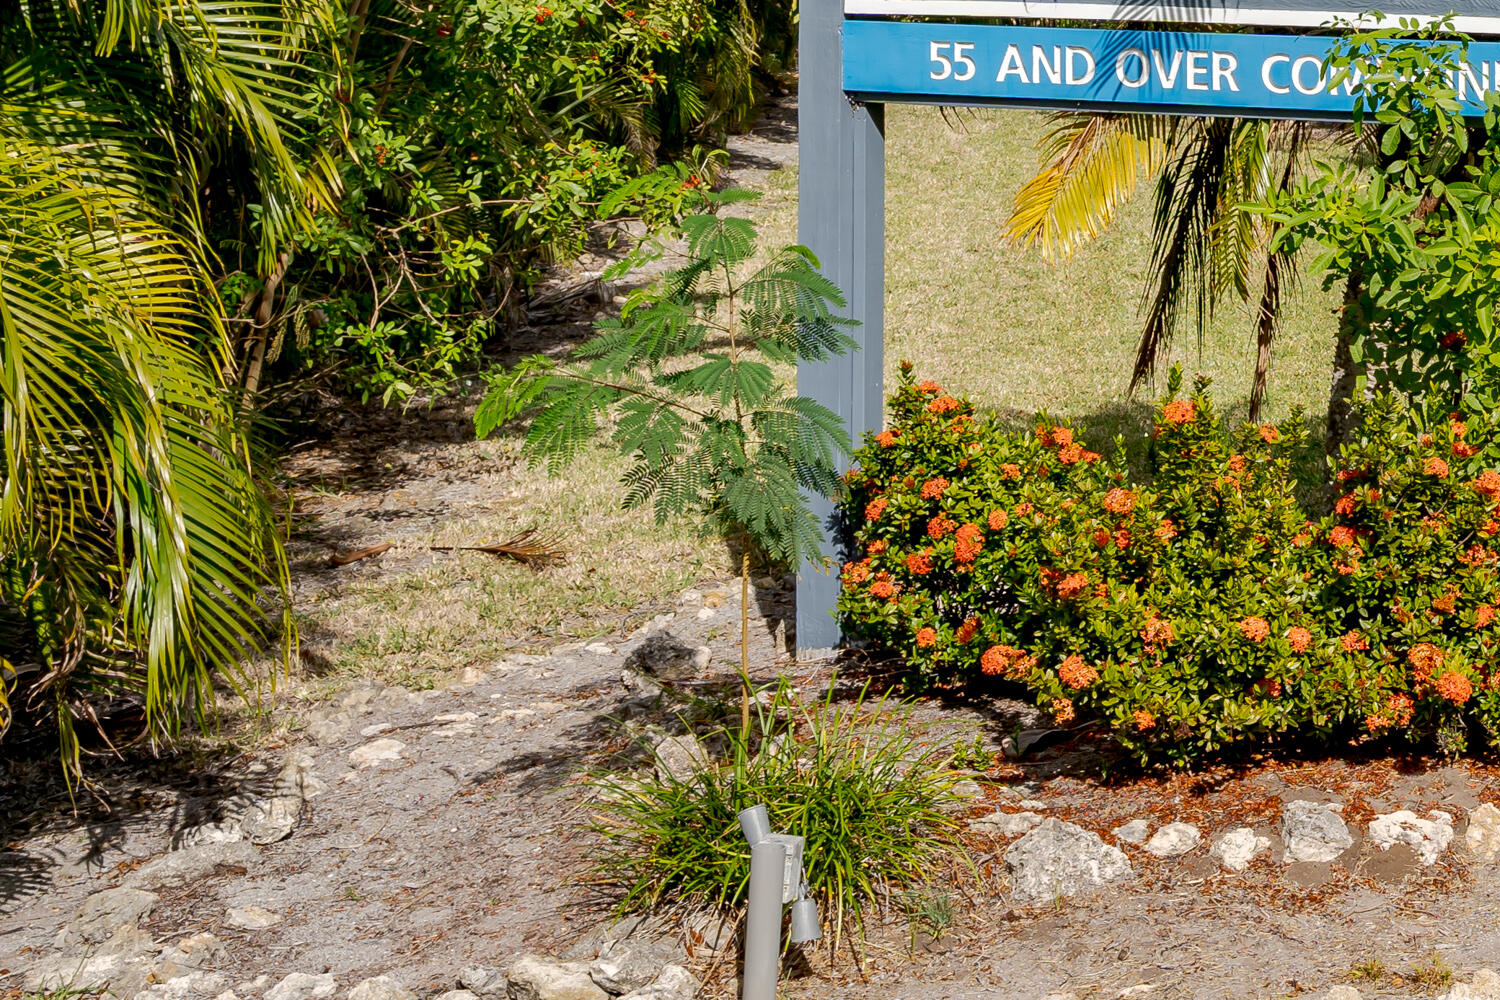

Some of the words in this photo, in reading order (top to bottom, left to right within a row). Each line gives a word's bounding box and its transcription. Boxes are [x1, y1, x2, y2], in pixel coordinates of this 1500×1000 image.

[929, 40, 977, 82] 55
[996, 43, 1096, 86] AND
[1115, 46, 1240, 93] OVER
